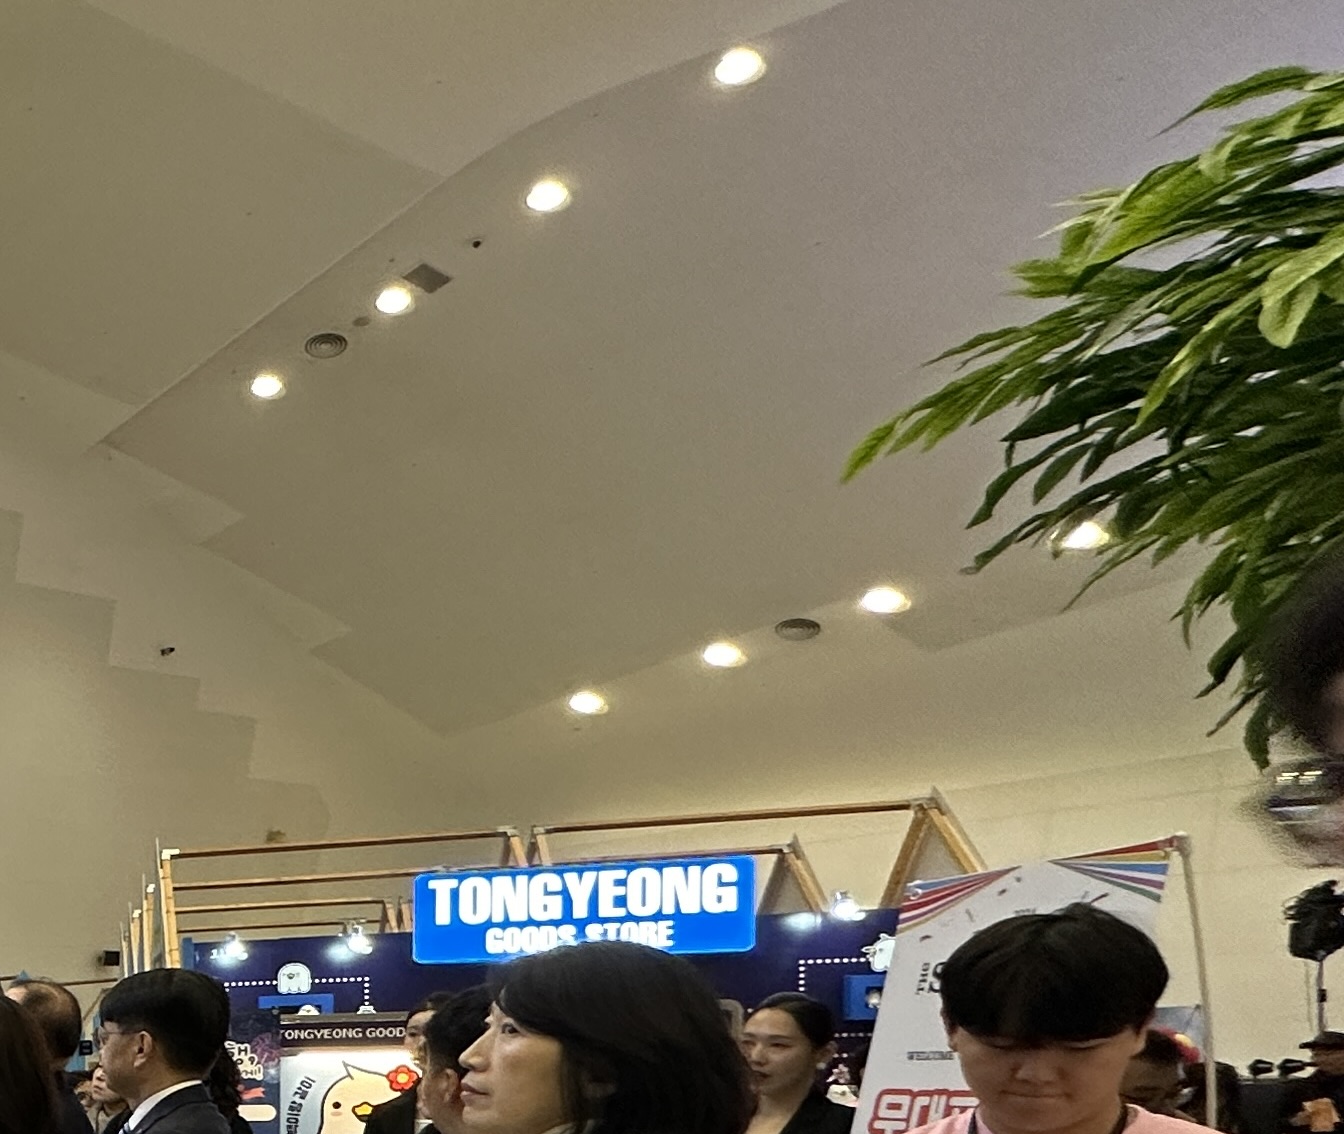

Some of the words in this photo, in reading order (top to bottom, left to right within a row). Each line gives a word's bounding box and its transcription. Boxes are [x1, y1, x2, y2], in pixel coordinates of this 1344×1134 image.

[427, 863, 740, 926] TONGYEONG
[485, 923, 577, 955] GOODS
[583, 919, 674, 948] STORE
